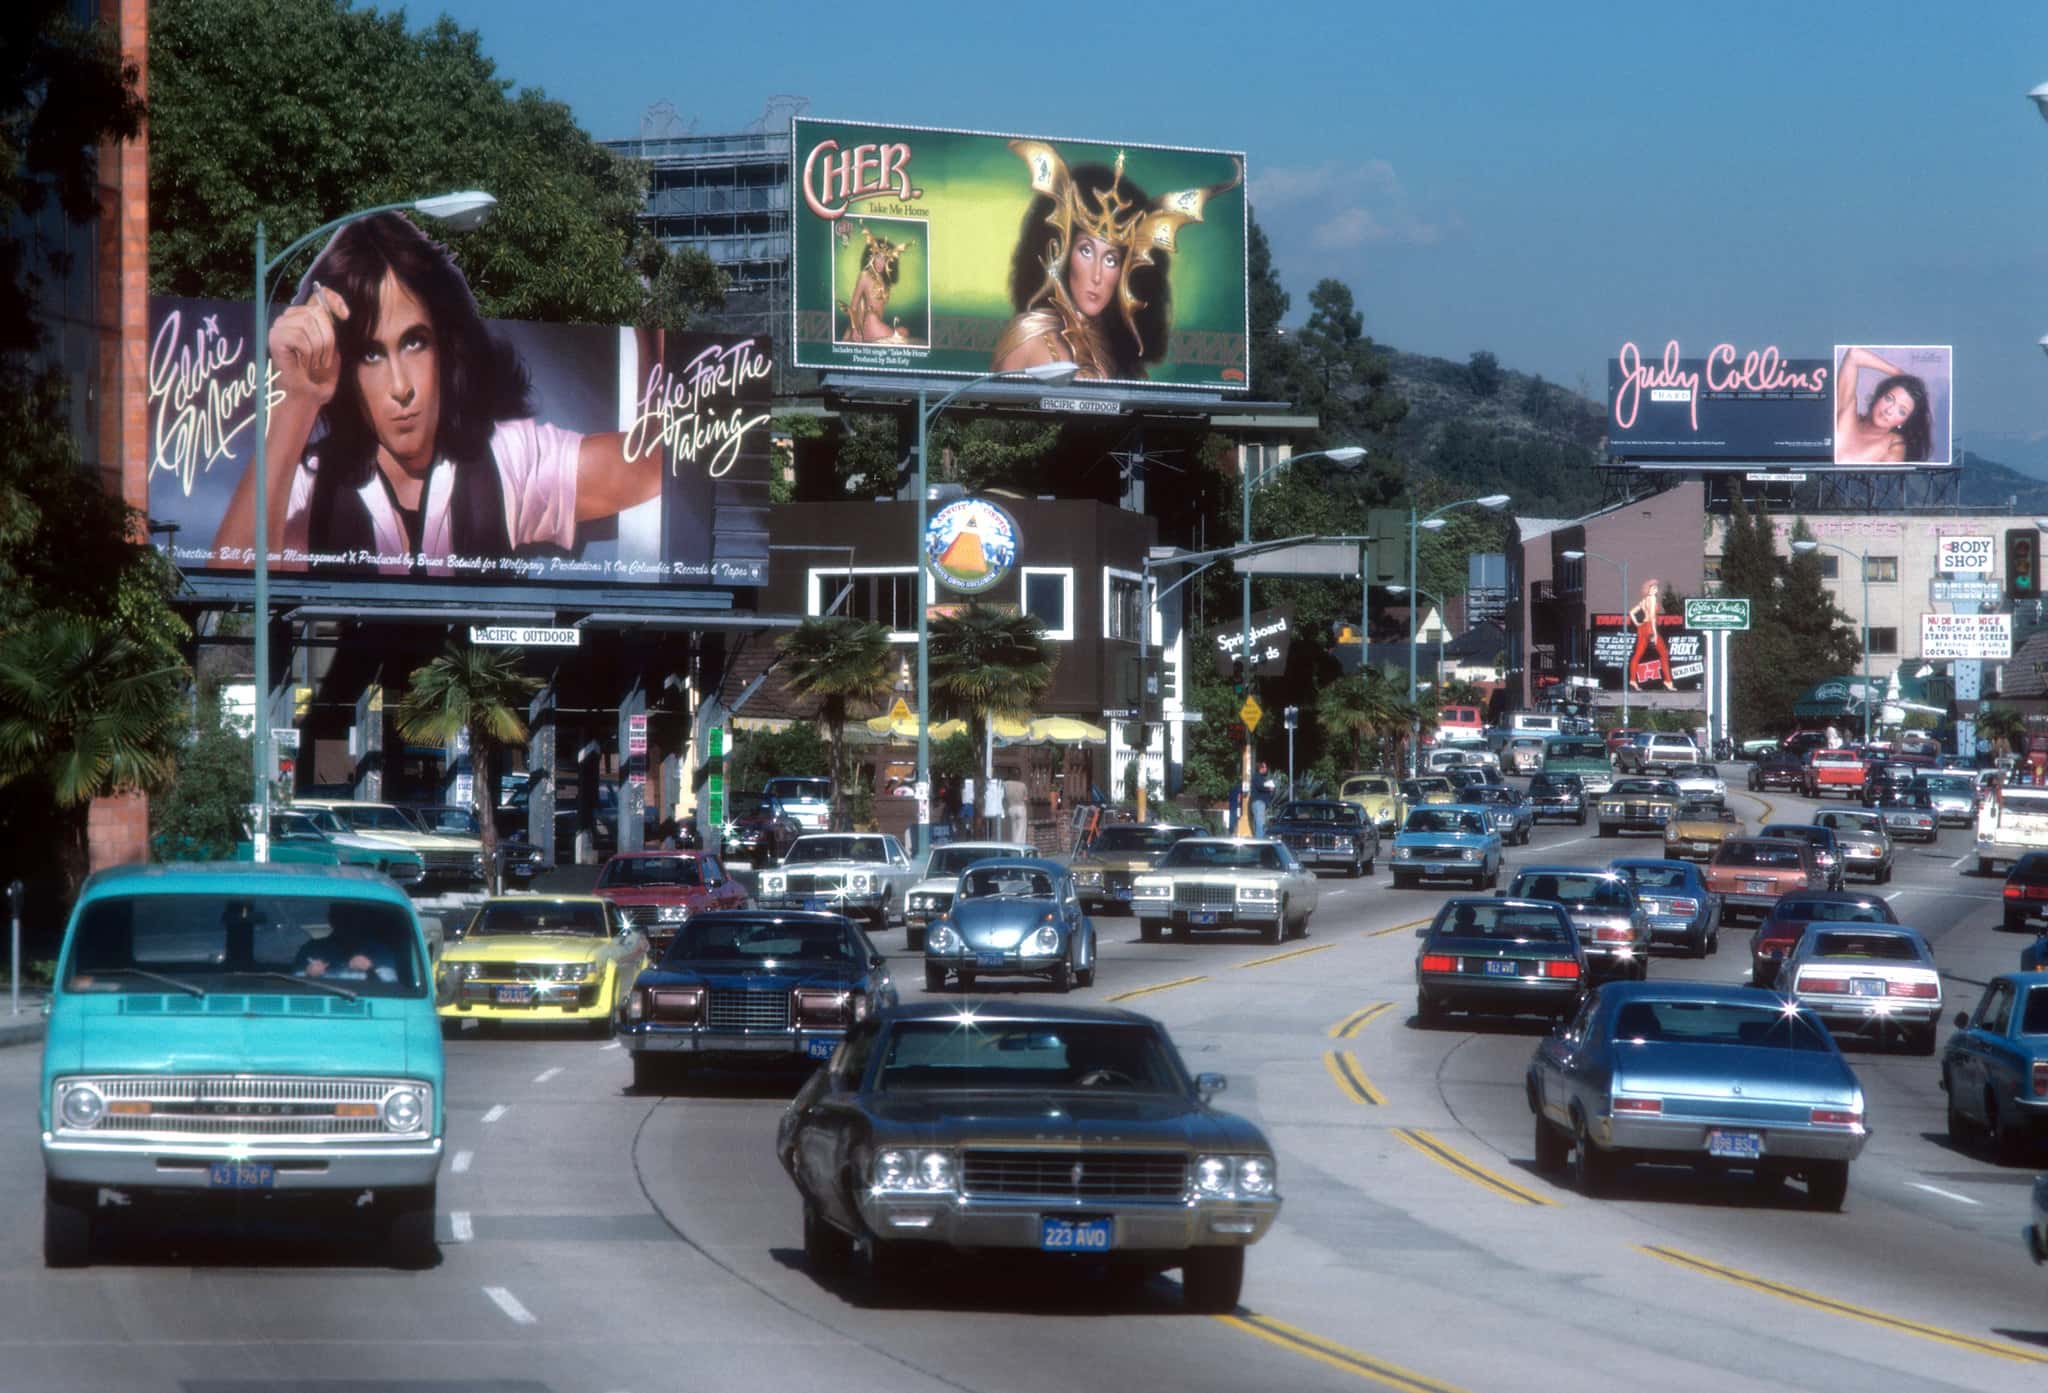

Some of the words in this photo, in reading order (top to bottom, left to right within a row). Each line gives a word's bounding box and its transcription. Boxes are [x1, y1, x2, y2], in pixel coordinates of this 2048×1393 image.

[803, 139, 923, 220] CHER
[870, 203, 889, 213] Take
[889, 204, 903, 214] Me
[904, 205, 929, 217] Home
[148, 310, 244, 458] Eddie
[1616, 340, 1699, 431] Judy
[1706, 343, 1828, 392] Collins
[623, 363, 692, 463] Life
[719, 339, 772, 396] The
[1043, 400, 1075, 409] PACIFIC
[1079, 401, 1118, 411] OUTDOOR
[148, 358, 287, 497] Money
[645, 408, 771, 478] Taking
[1951, 541, 1991, 553] BODY
[220, 545, 241, 560] Bill
[283, 548, 346, 566] Management
[358, 550, 404, 565] Produced
[404, 552, 415, 568] by
[417, 553, 444, 567] Bruce
[482, 557, 496, 573] for
[499, 557, 545, 575] Wolfgang
[551, 557, 601, 571] Productions
[628, 560, 670, 575] Columbia
[673, 561, 709, 575] Records
[721, 563, 748, 578] Tapes
[1945, 555, 1987, 567] SHOP
[1978, 617, 2000, 625] NICE
[475, 629, 517, 641] PACIFIC
[522, 630, 576, 643] OUTDOOR
[1980, 633, 2009, 641] SCREEN
[1670, 643, 1699, 655] ROXY
[1045, 1228, 1072, 1246] 223
